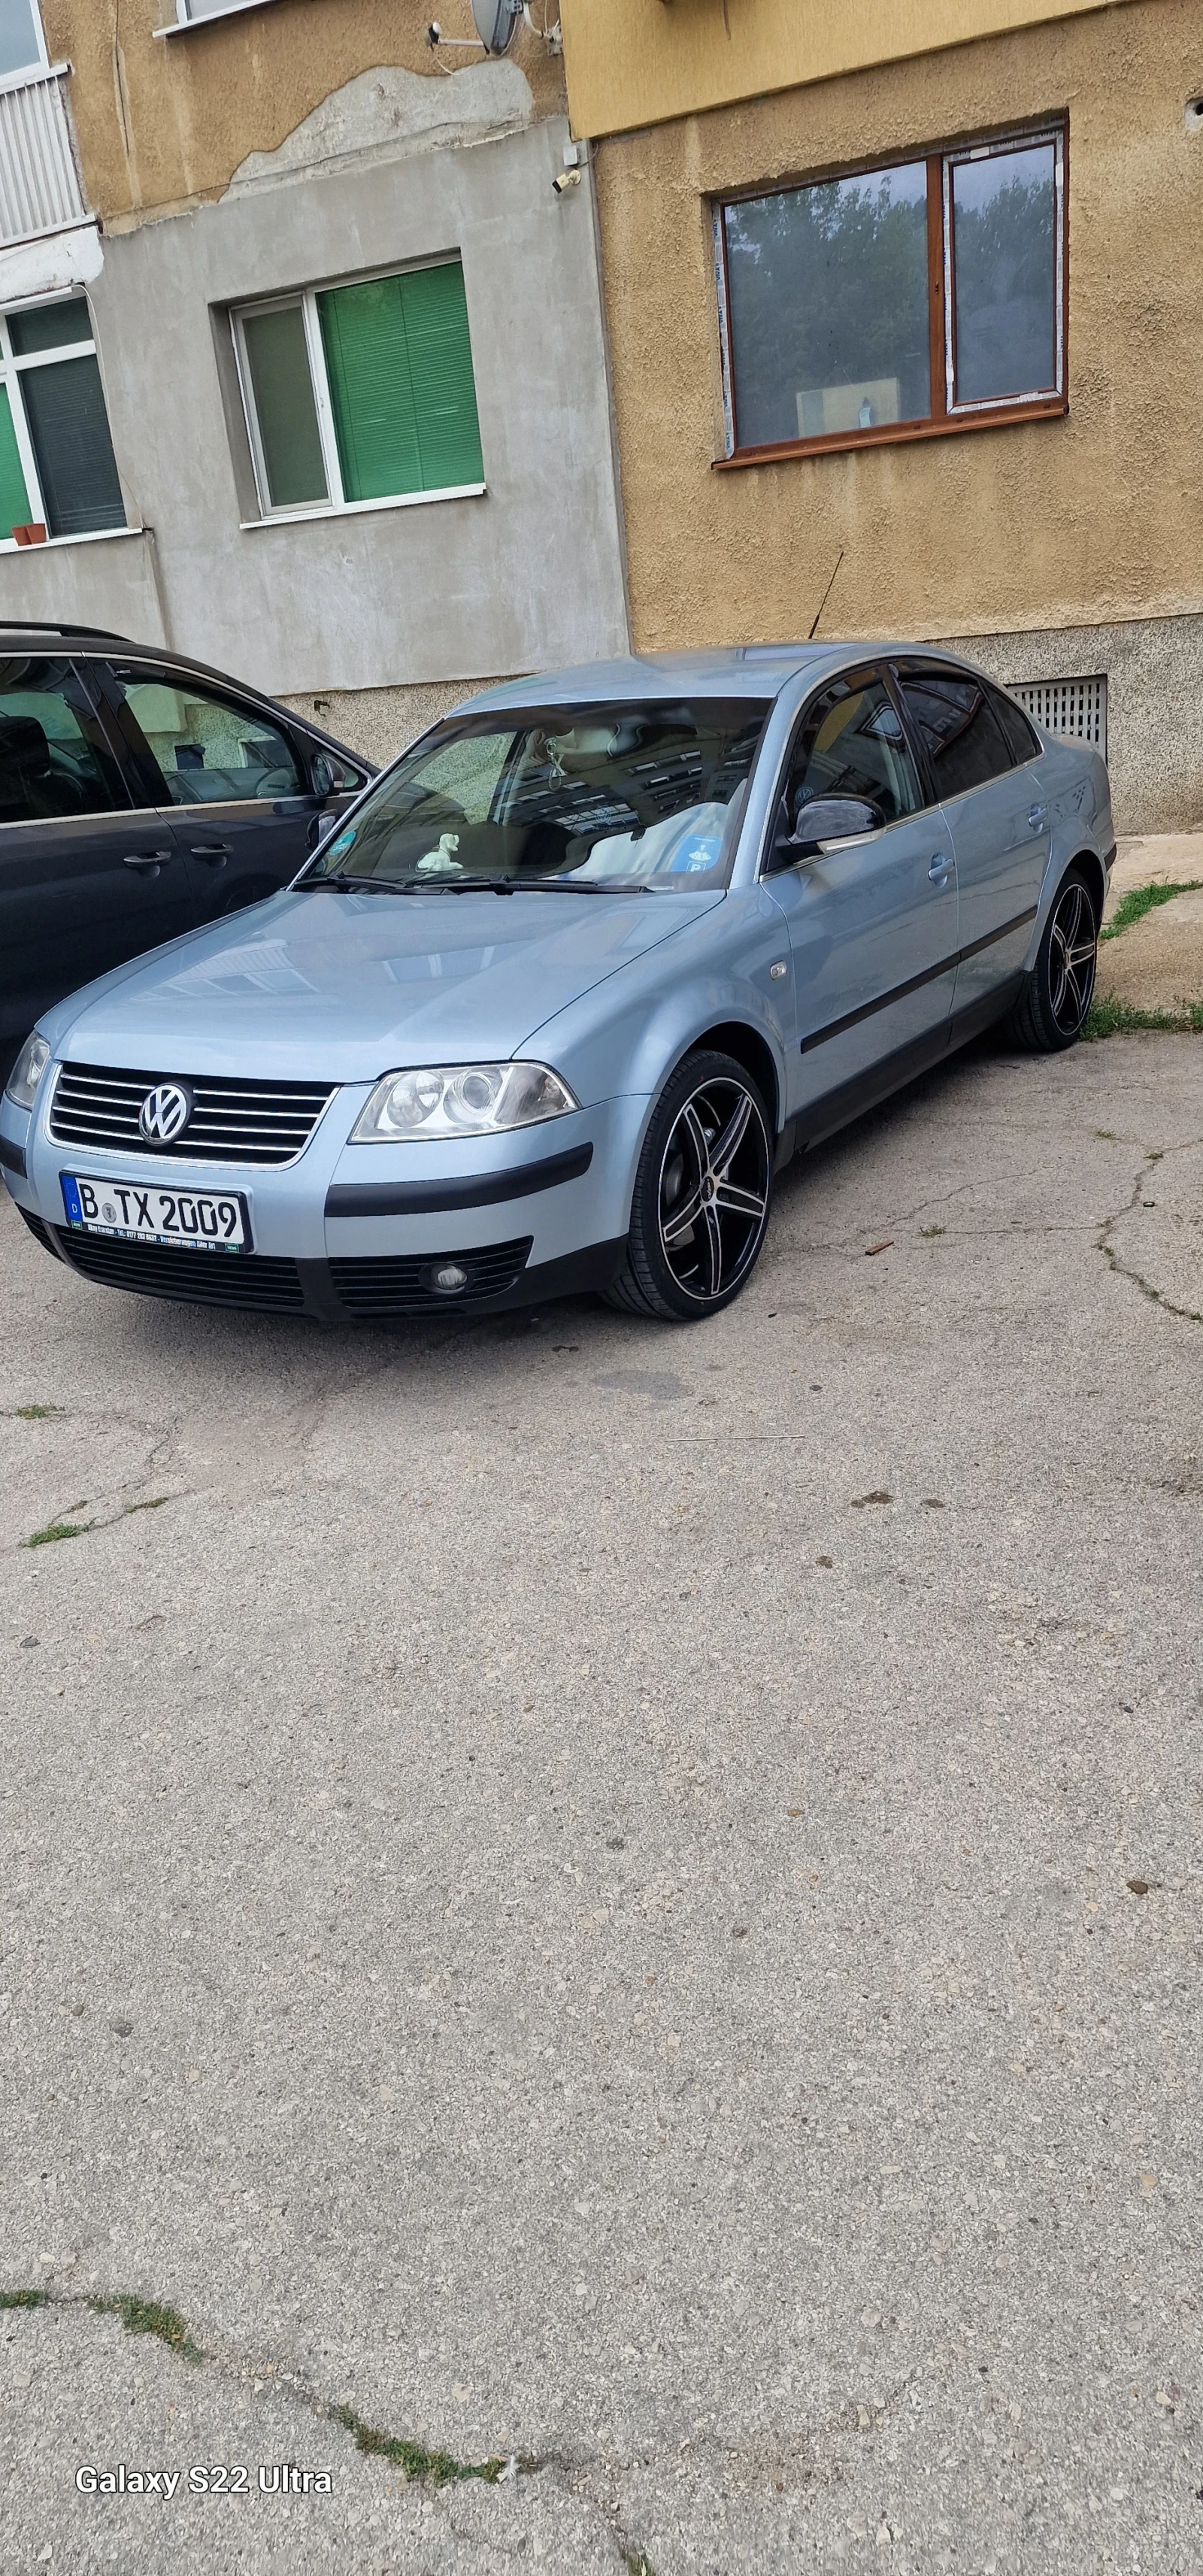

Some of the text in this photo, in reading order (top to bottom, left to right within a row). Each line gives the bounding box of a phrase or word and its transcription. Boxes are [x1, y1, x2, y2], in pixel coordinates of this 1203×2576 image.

[71, 1204, 78, 1214] D
[78, 1183, 237, 1238] B TX 2009
